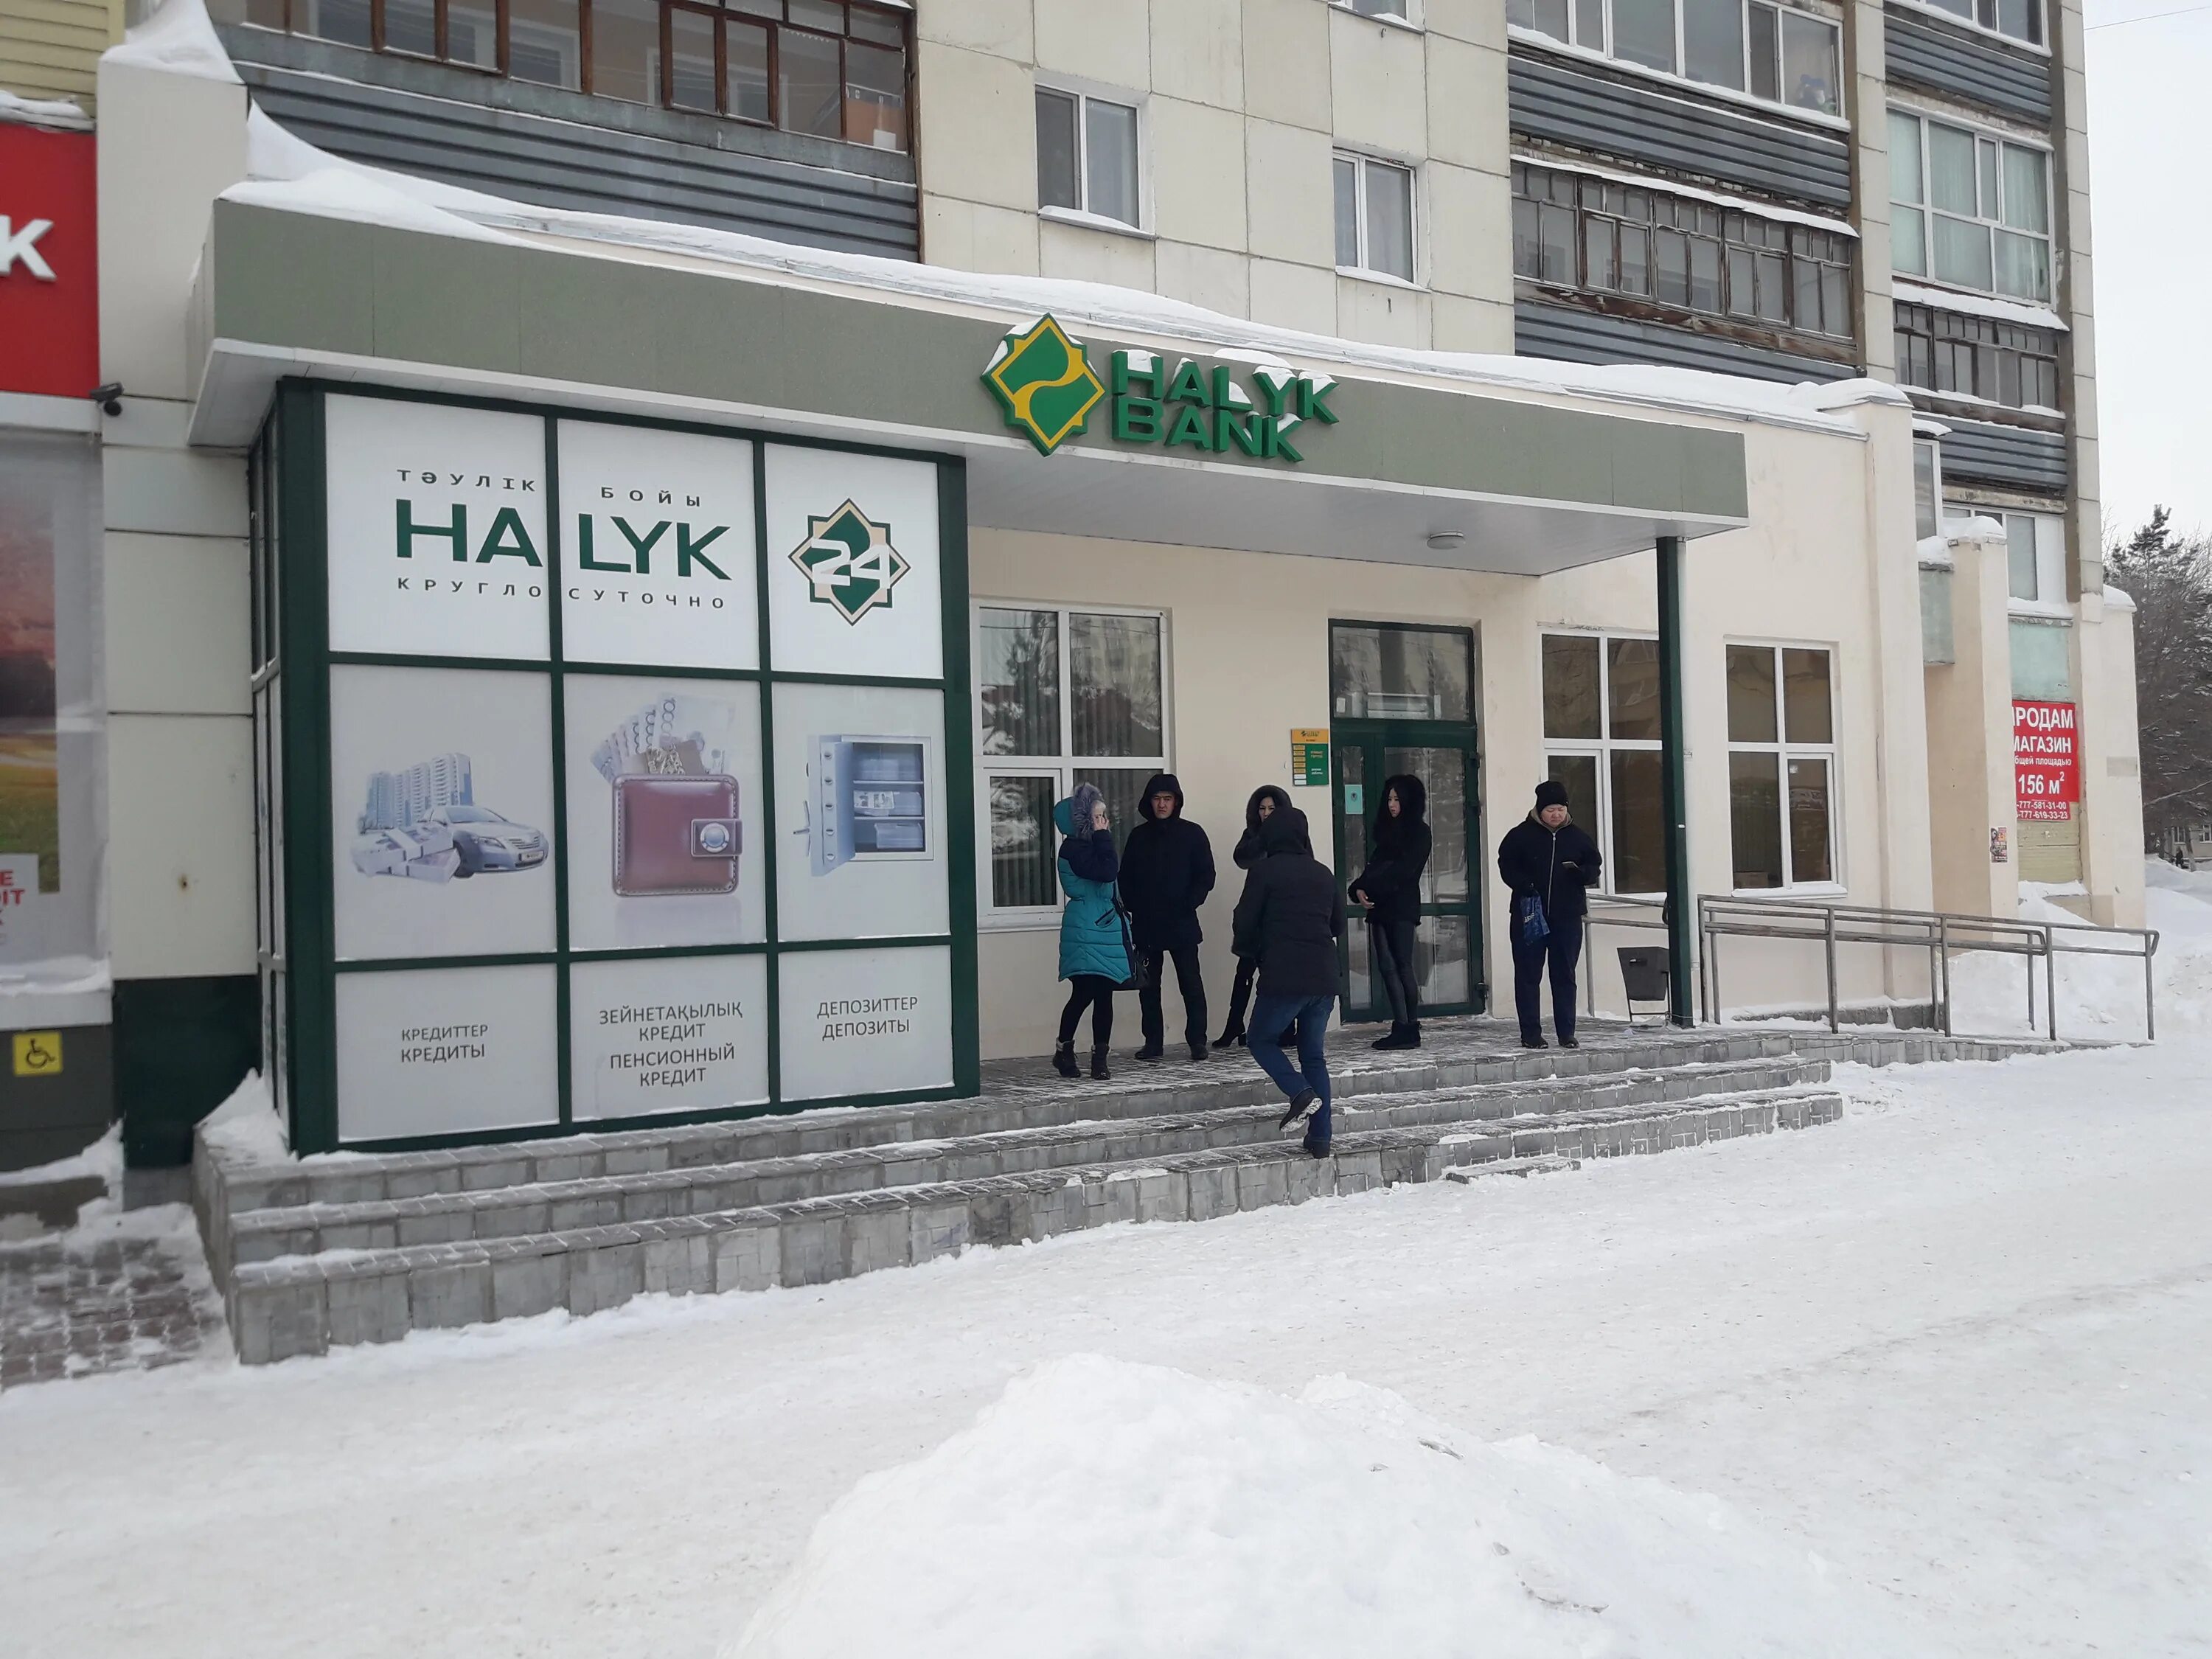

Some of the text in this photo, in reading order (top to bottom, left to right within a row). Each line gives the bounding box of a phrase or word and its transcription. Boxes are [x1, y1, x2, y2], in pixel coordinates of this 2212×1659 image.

[1112, 349, 1339, 424] HALYK
[1112, 396, 1304, 462] BANK
[397, 469, 700, 507] ТӘУЛІК БОЙЫ
[396, 498, 732, 581] HALYK
[810, 537, 891, 590] 24
[397, 577, 724, 609] КРУГЛОСУТОЧНО
[2014, 756, 2072, 767] бщей площадью
[2018, 773, 2044, 794] 156
[2017, 801, 2067, 810] -777-581-31-00
[0, 888, 26, 907] IT
[599, 1001, 743, 1025] ЗЕЙНЕТАҚЫЛЫҚ
[816, 996, 919, 1020] ДЕПОЗИТТЕР
[401, 1024, 488, 1043] КРЕДИТТЕР
[639, 1023, 706, 1043] КРЕДИТ
[821, 1019, 910, 1041] ДЕПОЗИТЫ
[400, 1043, 485, 1063] КРЕДИТЫ
[610, 1046, 735, 1070] ПЕНСИОННЫЙ
[640, 1067, 707, 1088] КРЕДИТ
